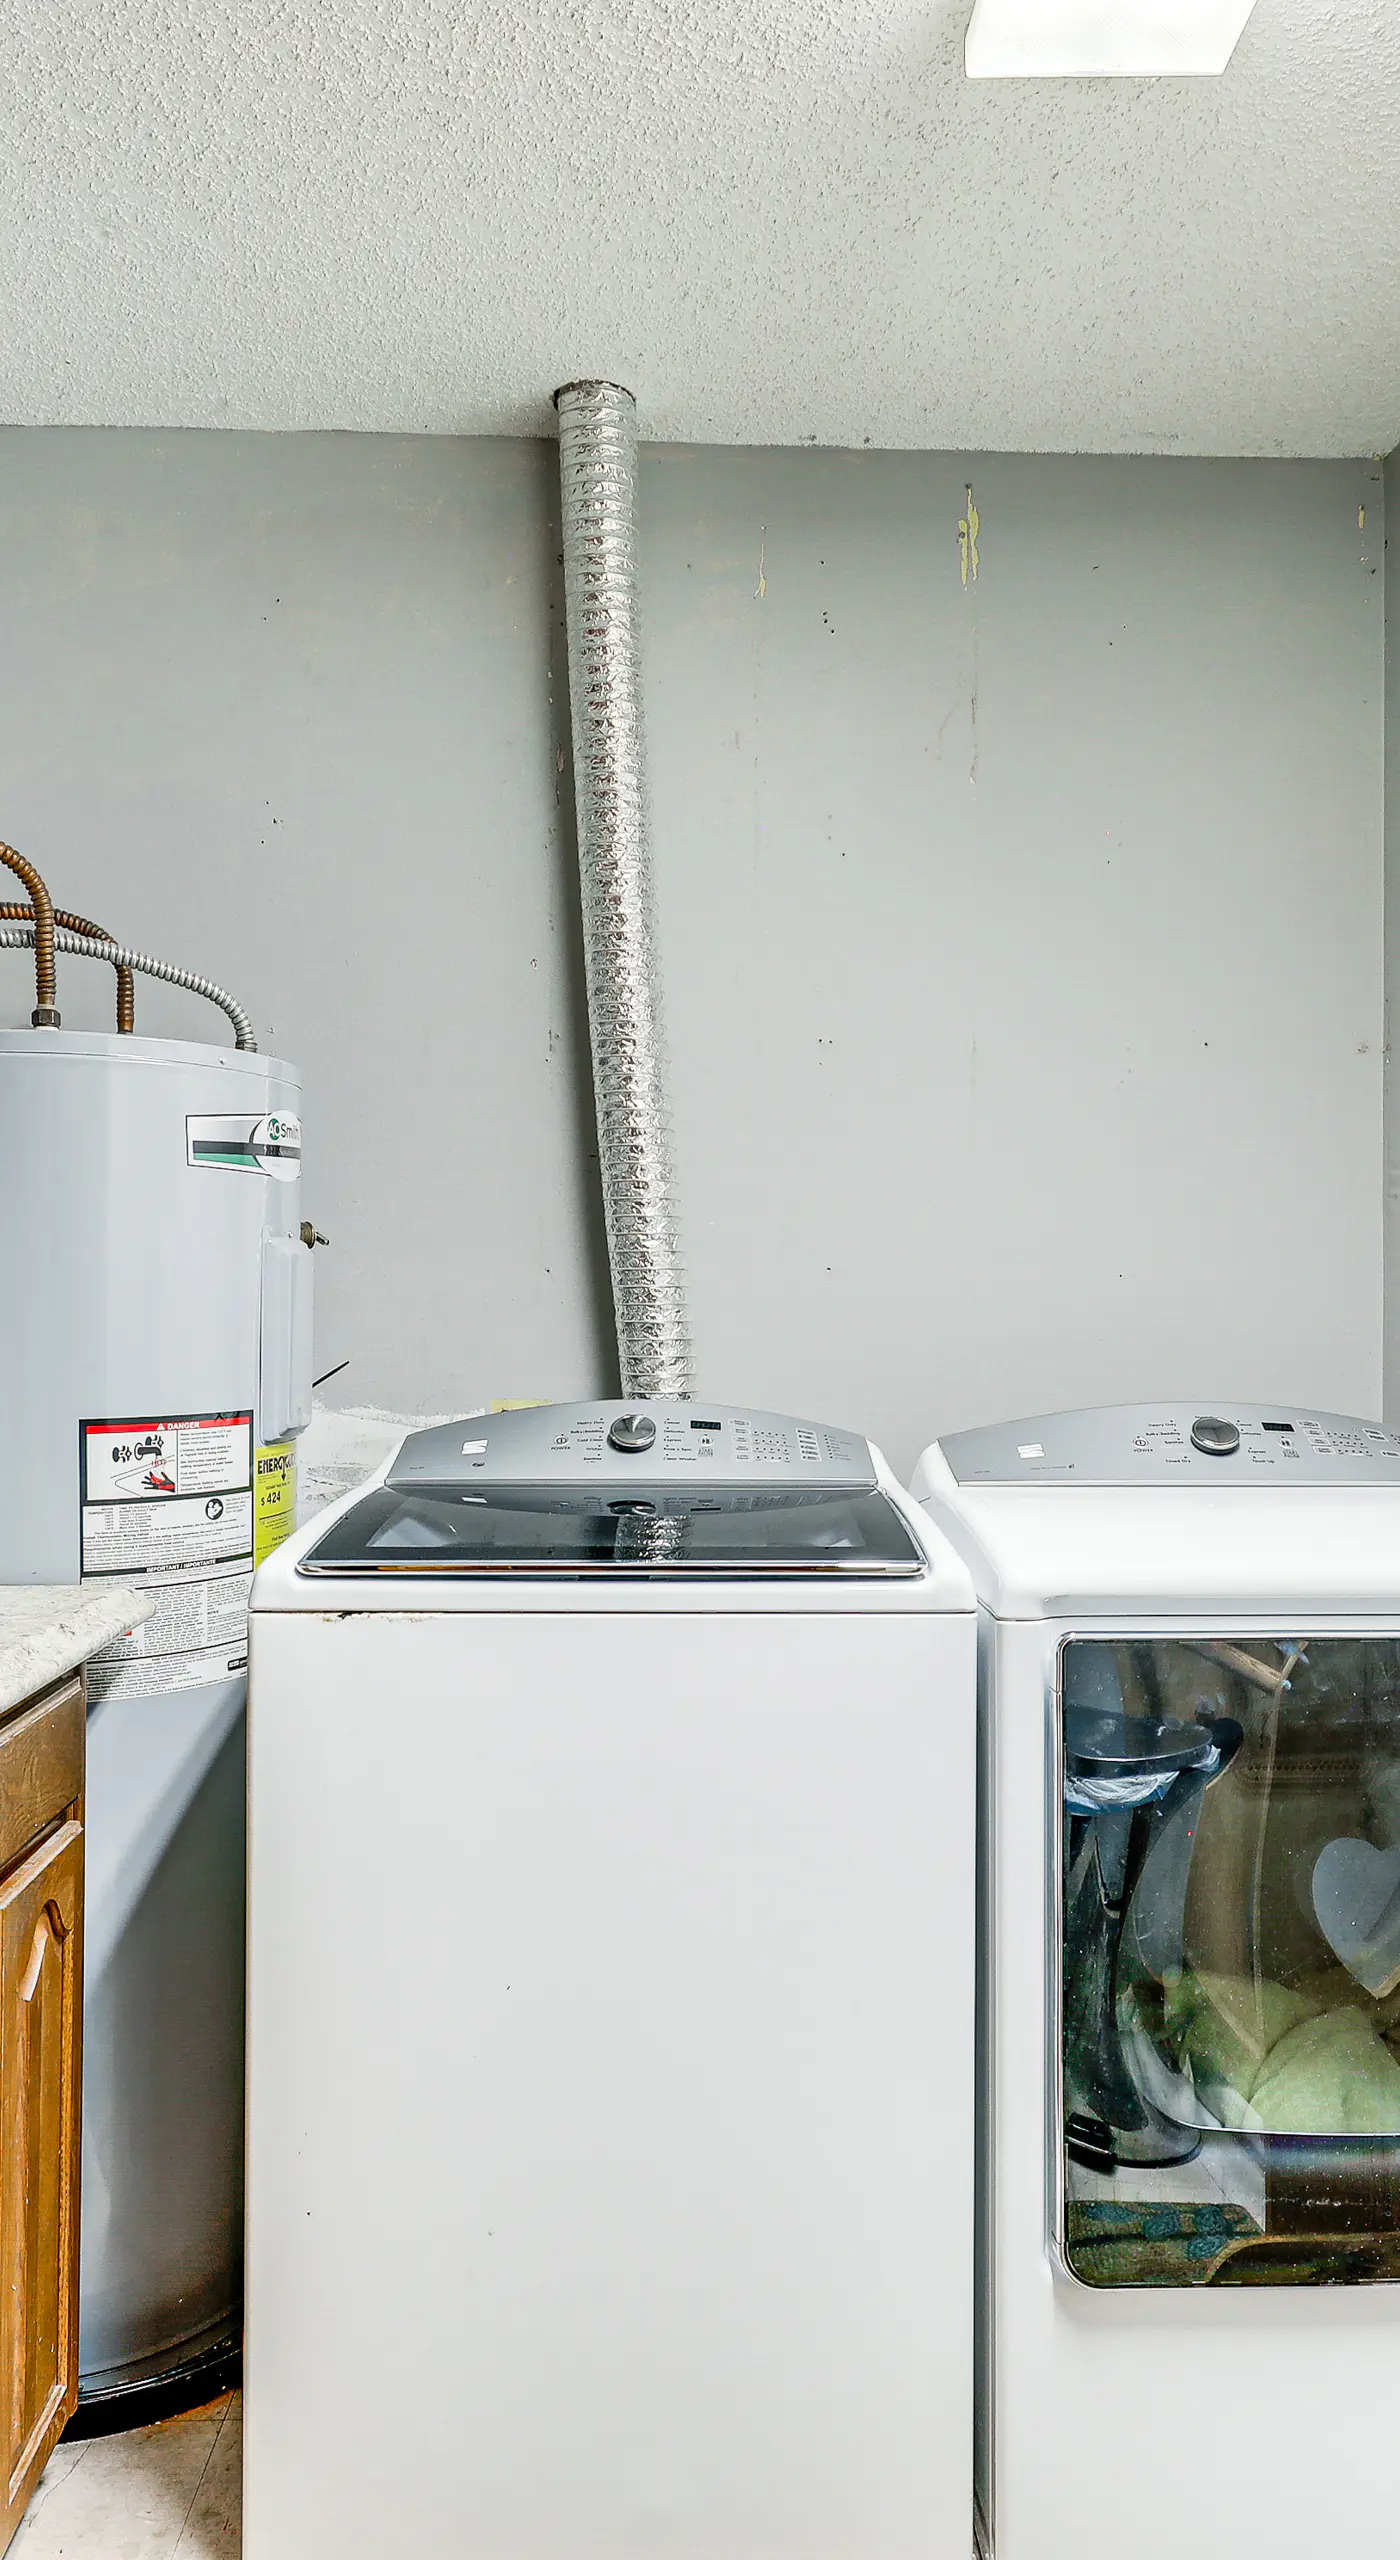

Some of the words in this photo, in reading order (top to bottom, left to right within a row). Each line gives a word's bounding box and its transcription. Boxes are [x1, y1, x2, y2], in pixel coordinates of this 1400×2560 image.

[167, 1421, 200, 1430] DANGER
[267, 1491, 281, 1504] 424
[146, 1563, 180, 1573] IMPORTANT
